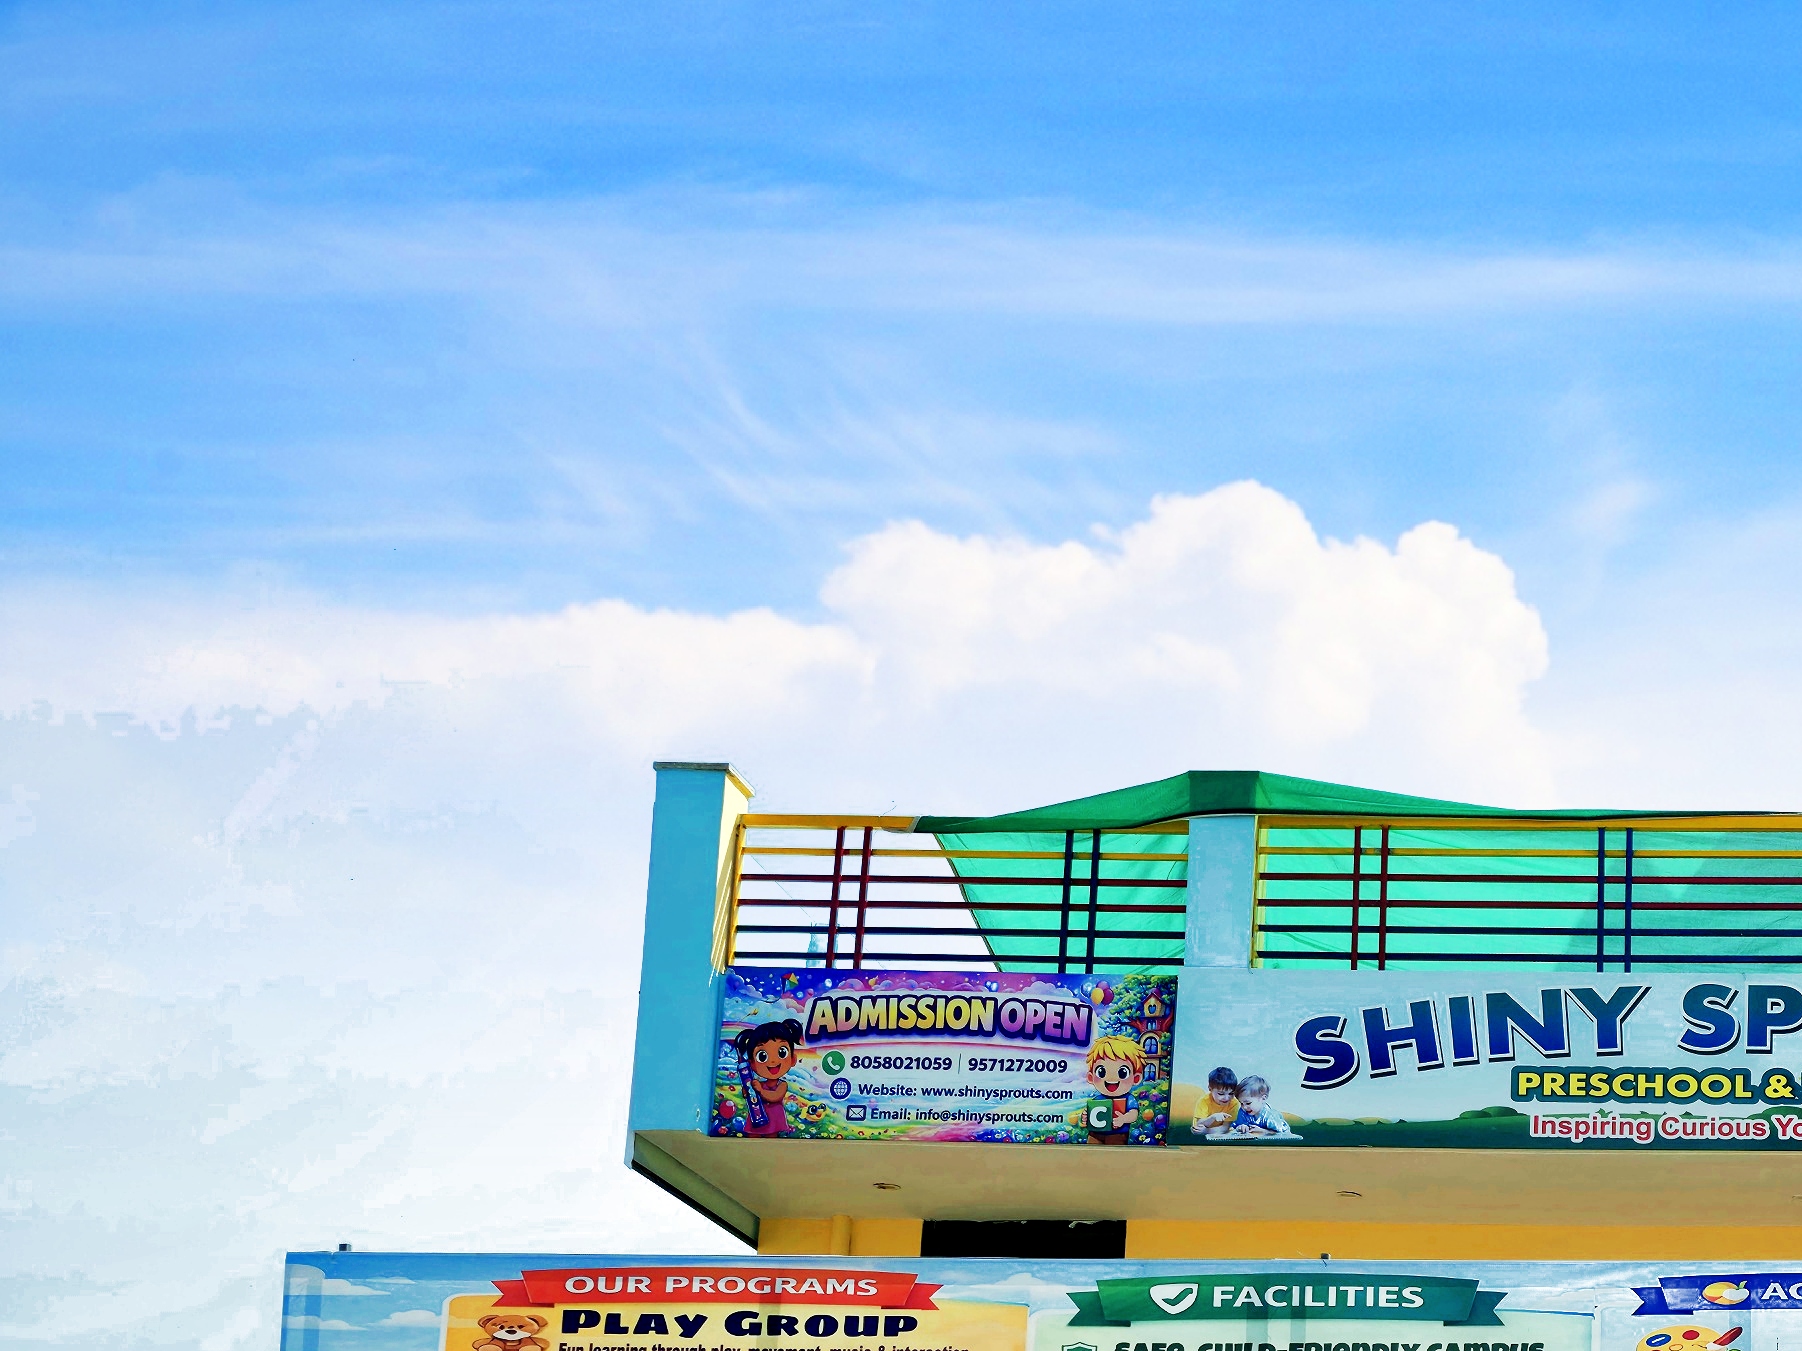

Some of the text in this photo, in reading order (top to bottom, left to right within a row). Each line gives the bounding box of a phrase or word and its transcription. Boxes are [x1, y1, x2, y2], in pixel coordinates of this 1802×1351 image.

[807, 996, 1090, 1042] ADMISSION OPEN
[1295, 985, 1652, 1091] SHINY
[850, 1055, 1068, 1073] 8058021059 9571272009
[858, 1083, 1073, 1101] Website: www.shinysprouts.com
[1518, 1072, 1752, 1098] PRESCHOOL
[1764, 1074, 1795, 1099] &
[870, 1108, 1064, 1124] Email: info@shinysprouts.com
[1089, 1106, 1108, 1128] C
[1532, 1115, 1652, 1141] Inspiring
[1661, 1117, 1767, 1137] Curious
[564, 1276, 878, 1296] OUR PROGRAMS
[1213, 1285, 1424, 1308] FACILITIES
[561, 1309, 918, 1338] PLAY GROUP
